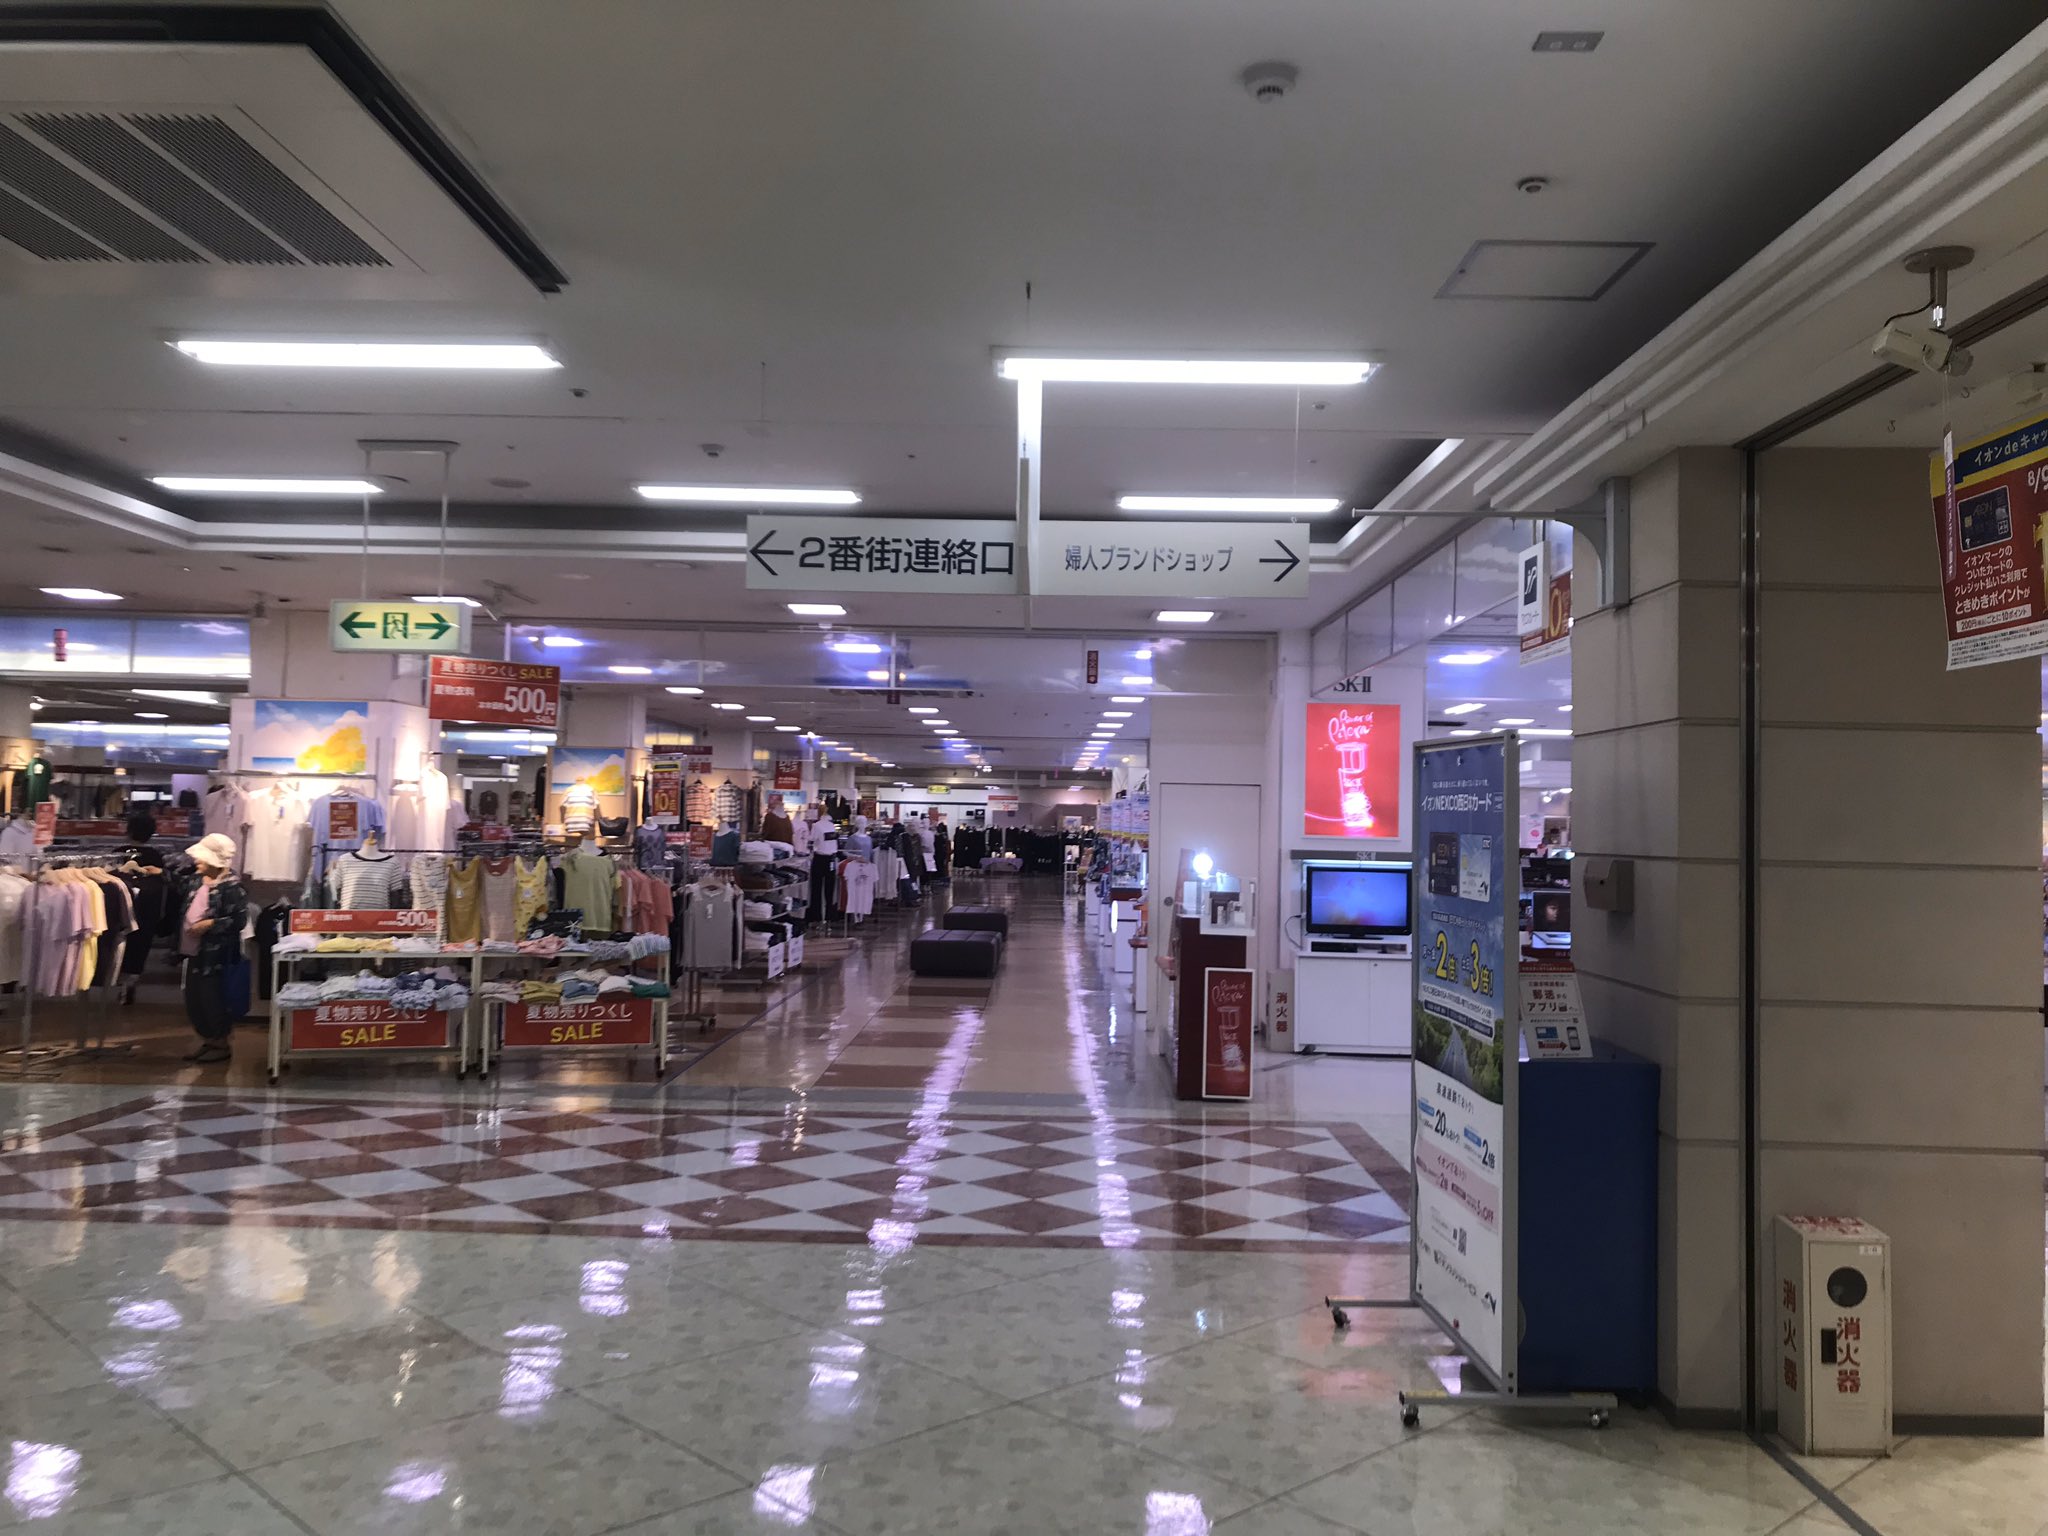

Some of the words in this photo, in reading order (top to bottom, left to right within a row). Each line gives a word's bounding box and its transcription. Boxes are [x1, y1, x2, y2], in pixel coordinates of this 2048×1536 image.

[798, 535, 1014, 576] 2番街連絡口
[1064, 544, 1233, 573] 婦人ブランドショップ
[1963, 544, 2013, 568] イオンマークの
[1954, 567, 2029, 598] クレジット払いご利用で
[1965, 558, 2014, 581] ついたカードの
[1955, 585, 2031, 615] ときめきポイントが
[440, 659, 518, 678] 夏物売りつくし
[519, 667, 554, 680] SALE
[314, 1005, 428, 1022] 夏物売りつくし
[525, 1002, 634, 1020] 夏物売りつくし
[1275, 991, 1289, 1033] 消火器
[339, 1024, 397, 1047] SALE
[550, 1022, 604, 1044] SALE
[1783, 1278, 1798, 1392] 消火器
[1836, 1316, 1862, 1394] 消火器
